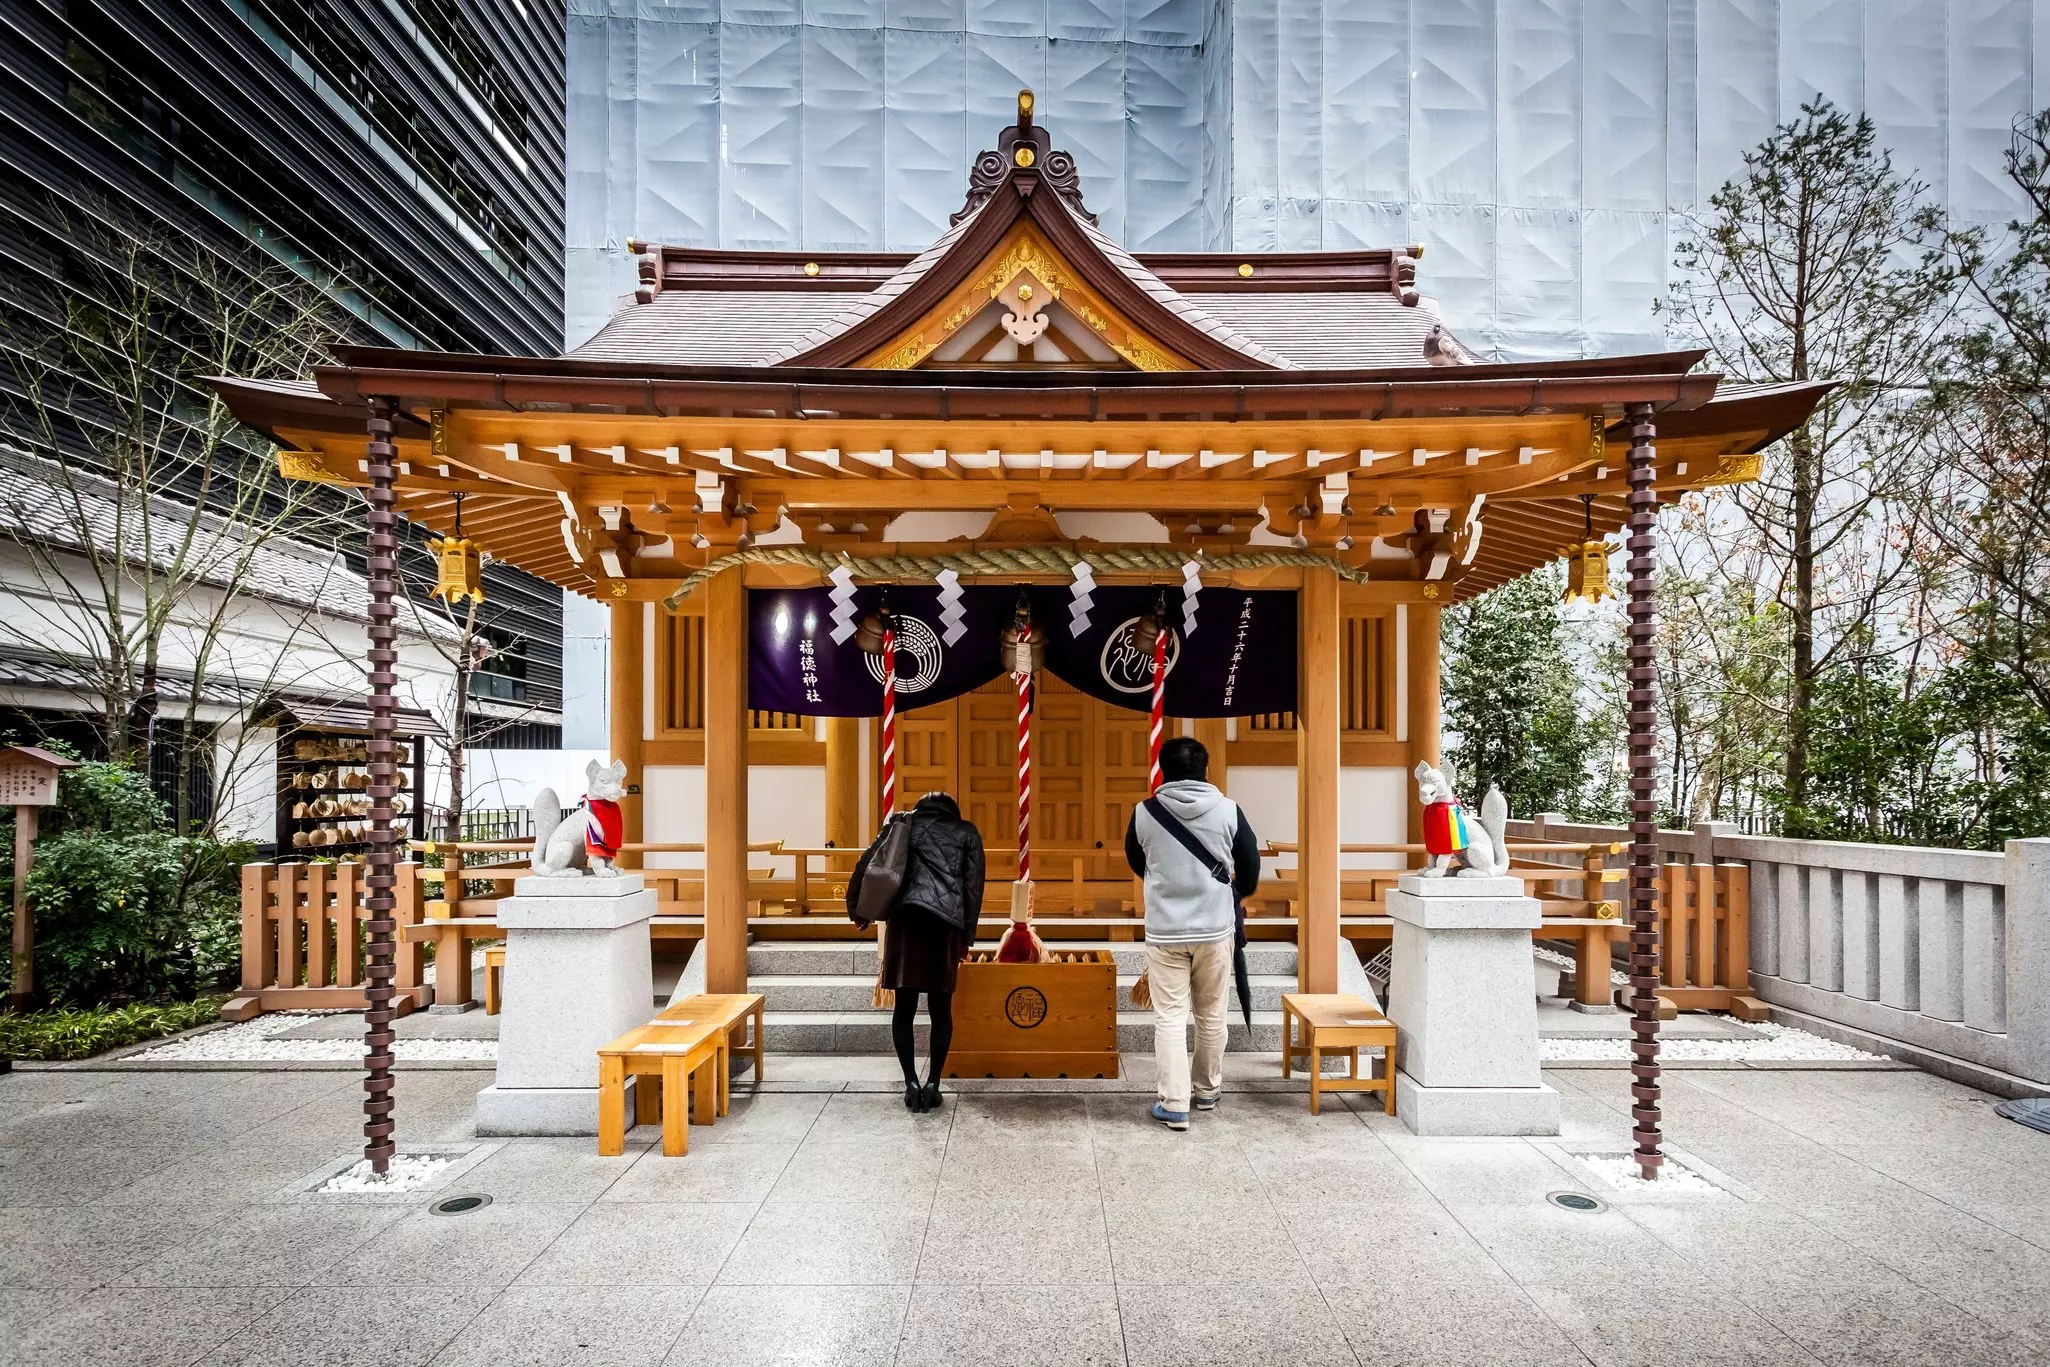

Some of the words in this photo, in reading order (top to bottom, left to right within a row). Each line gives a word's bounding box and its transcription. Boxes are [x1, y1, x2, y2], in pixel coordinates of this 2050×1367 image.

[799, 639, 822, 703] 福徳神社
[1223, 597, 1253, 706] 平成二十六年十月吉日
